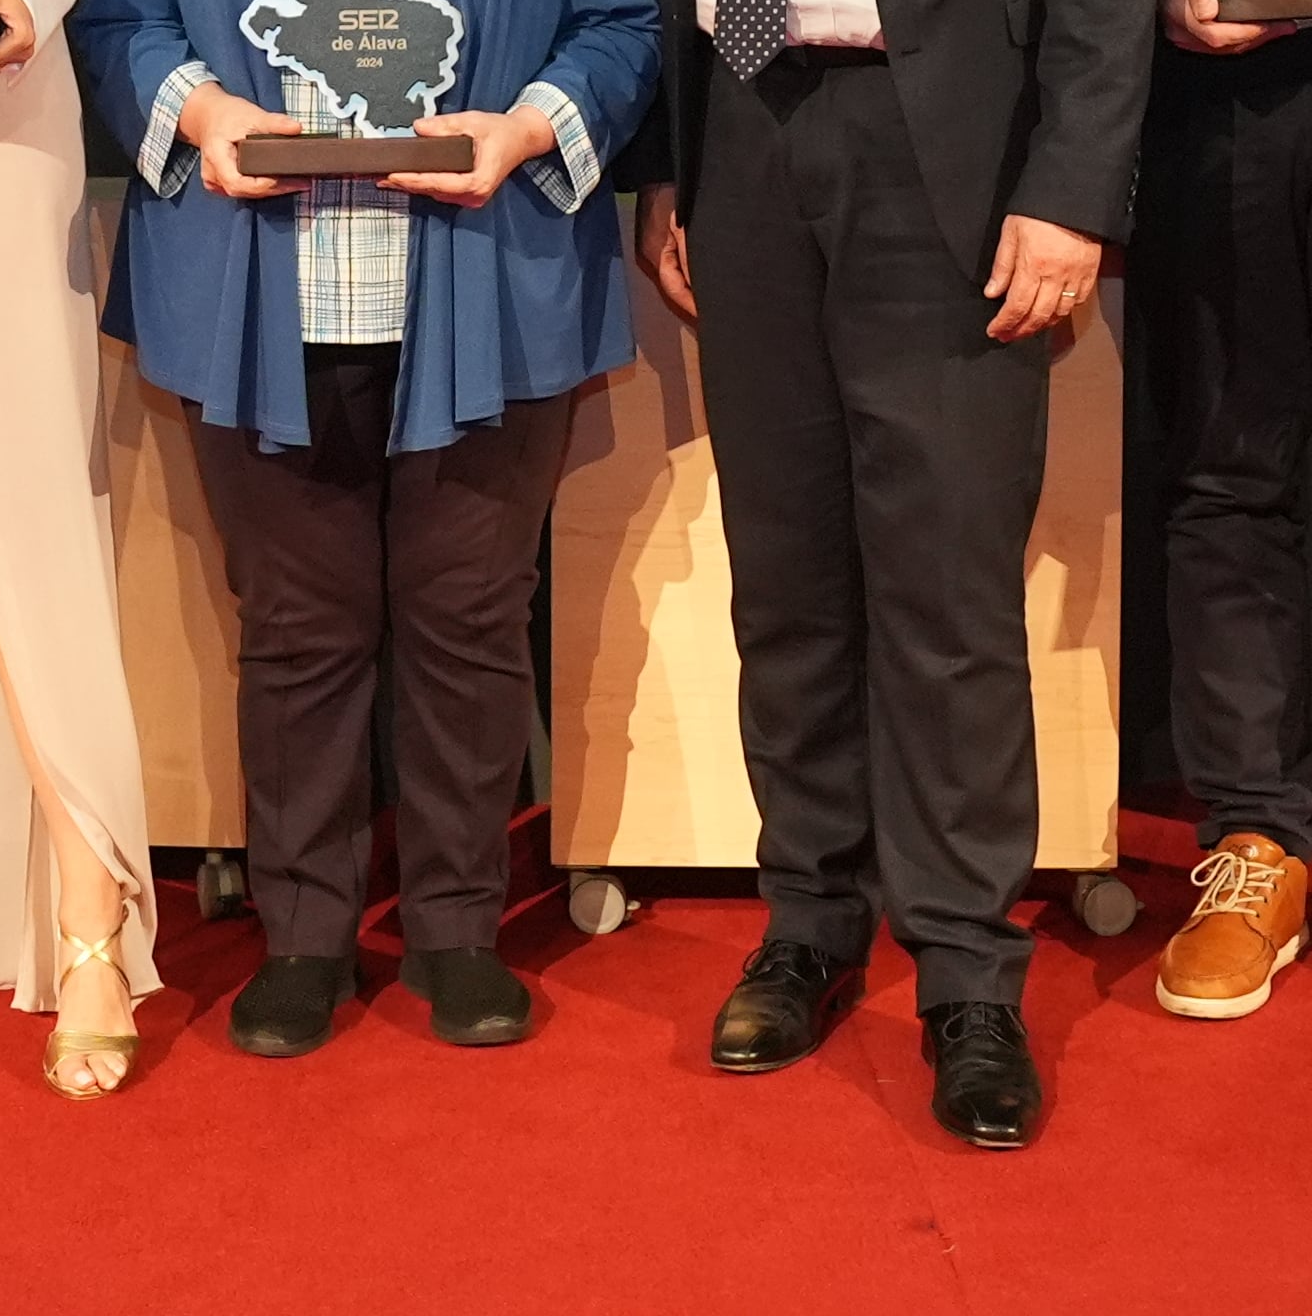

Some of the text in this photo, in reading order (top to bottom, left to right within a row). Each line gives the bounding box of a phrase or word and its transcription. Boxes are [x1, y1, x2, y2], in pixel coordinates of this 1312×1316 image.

[338, 9, 399, 30] SER
[331, 32, 408, 51] de Álava
[356, 57, 384, 68] 2024
